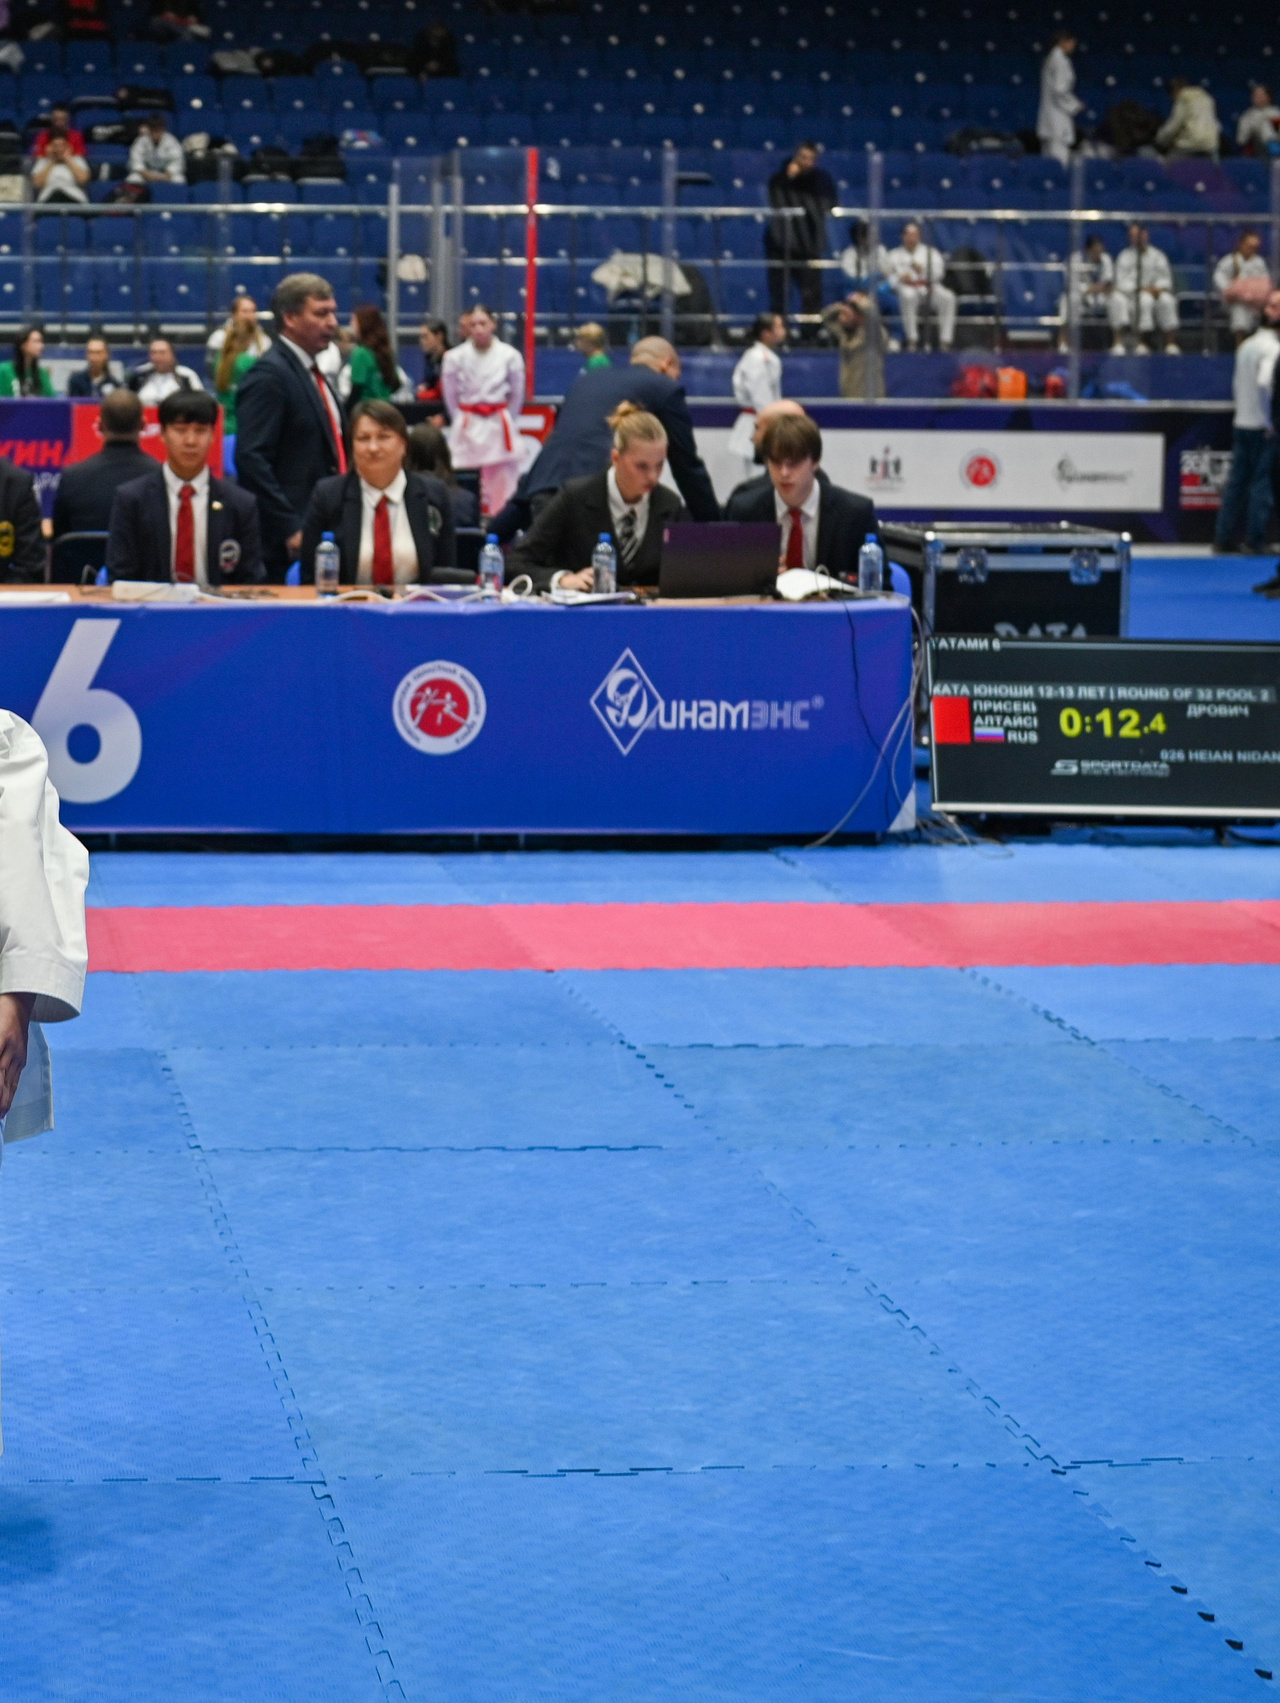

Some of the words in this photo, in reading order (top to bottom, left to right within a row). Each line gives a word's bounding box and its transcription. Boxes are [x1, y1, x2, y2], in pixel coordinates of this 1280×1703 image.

[973, 684, 1034, 698] ЮНОШИ
[1038, 685, 1074, 699] 12-13
[1078, 686, 1106, 699] ЛЕТ
[1118, 687, 1169, 700] ROUND
[1172, 687, 1193, 701] OF
[1217, 688, 1257, 701] POOL
[29, 618, 143, 804] 6
[1007, 730, 1038, 744] RUS
[1188, 750, 1233, 763] HEIAN
